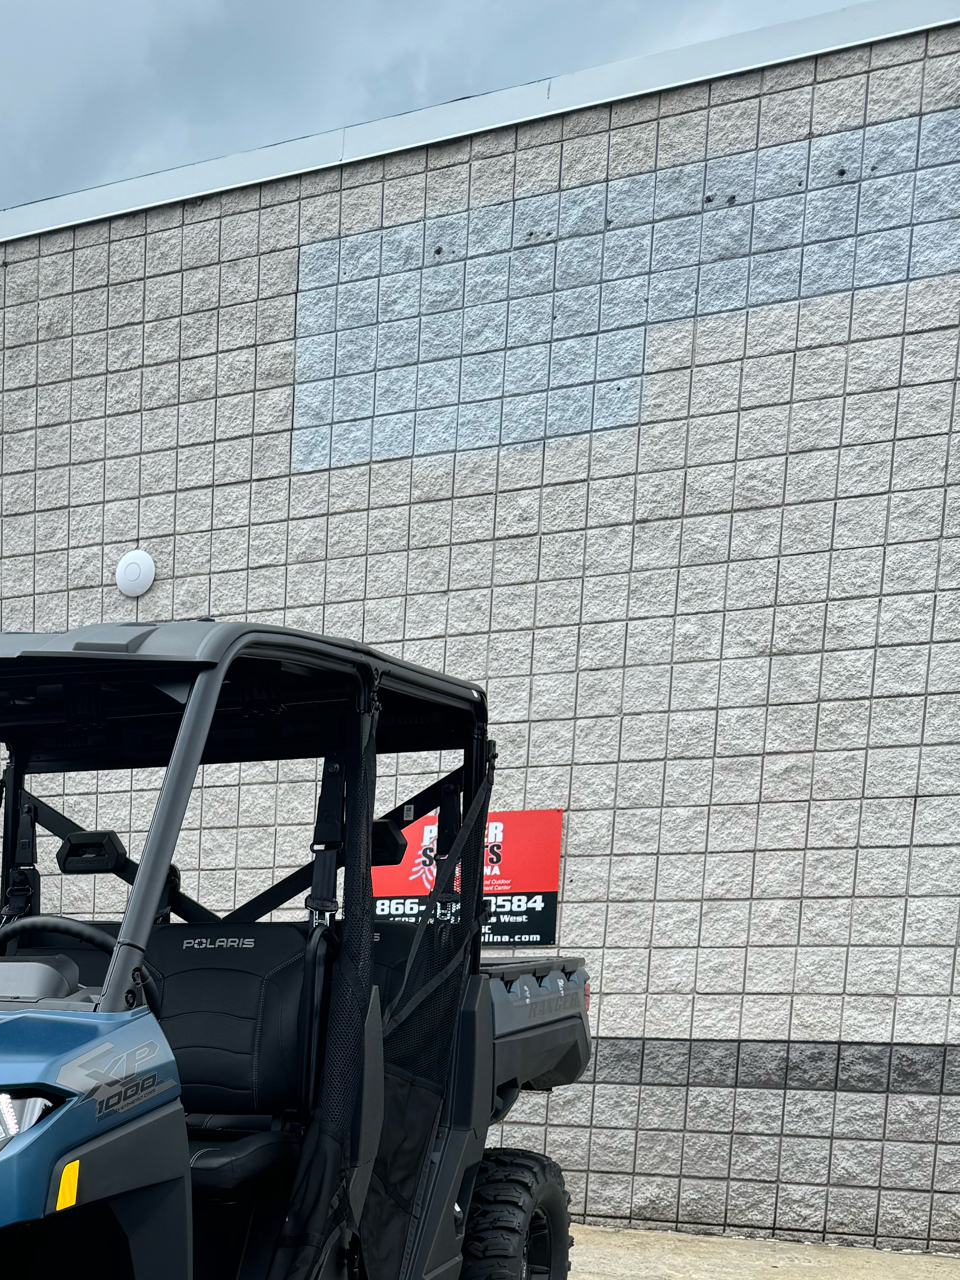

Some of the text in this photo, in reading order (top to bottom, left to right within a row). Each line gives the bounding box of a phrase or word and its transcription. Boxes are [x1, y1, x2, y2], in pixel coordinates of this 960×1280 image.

[499, 914, 529, 923] West
[182, 938, 255, 949] POLARIS
[96, 1072, 157, 1116] 1000
